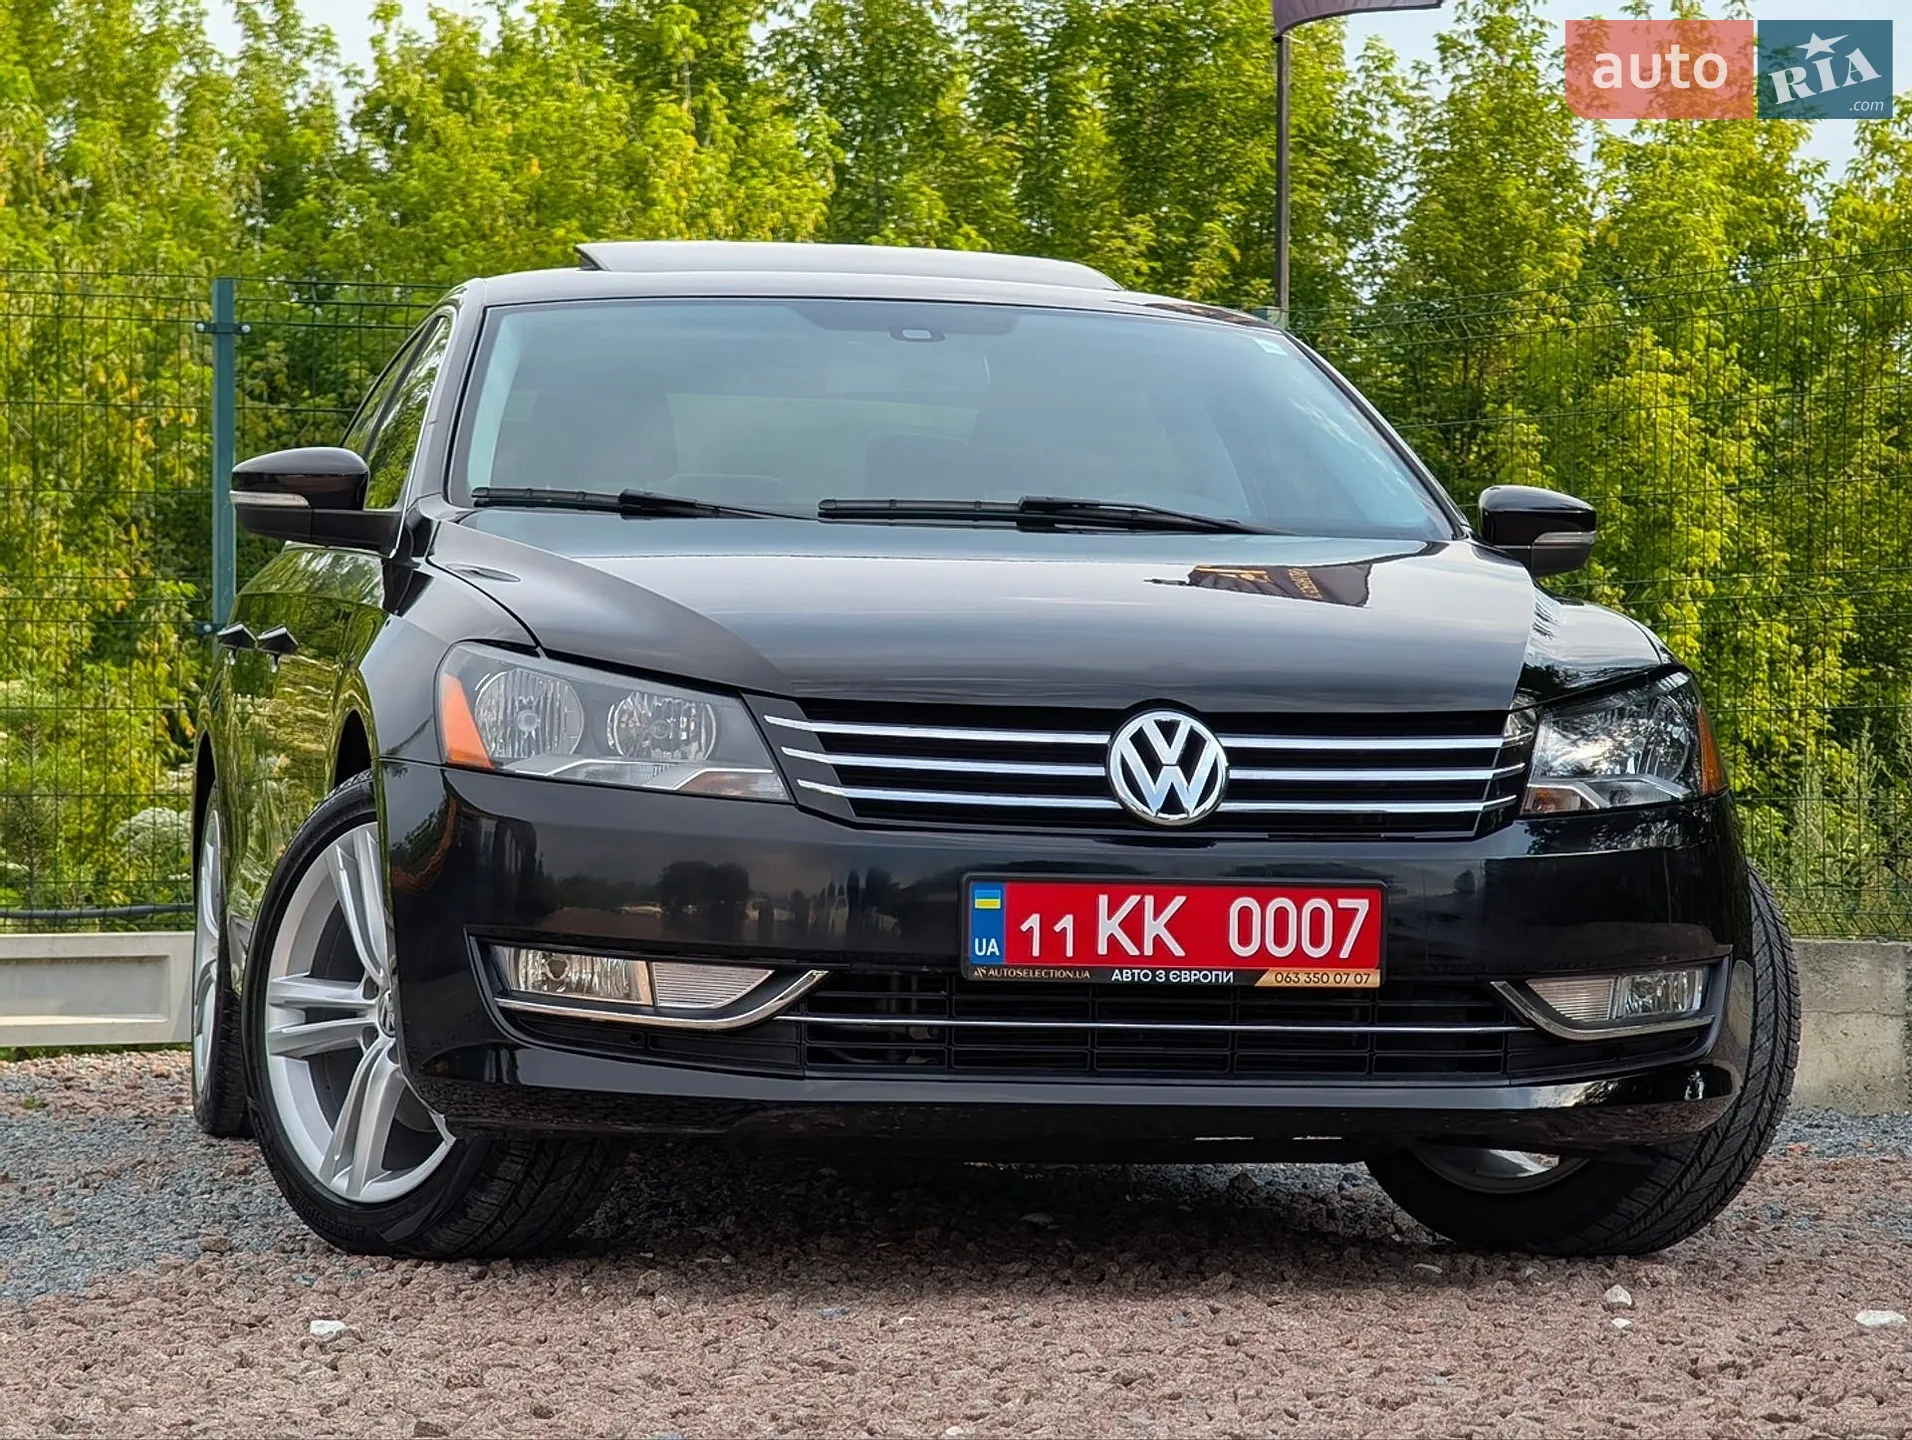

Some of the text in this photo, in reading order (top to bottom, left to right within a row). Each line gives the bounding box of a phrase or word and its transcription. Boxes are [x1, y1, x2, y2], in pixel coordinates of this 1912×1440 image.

[1020, 894, 1370, 959] 11 KK 0007
[974, 938, 1000, 956] UA
[988, 967, 1091, 979] AUTOSELECTION.UA
[1111, 969, 1152, 982] АВТО
[1169, 970, 1234, 983] ЄВРОПИ
[1274, 972, 1371, 984] 063 350 07 07
